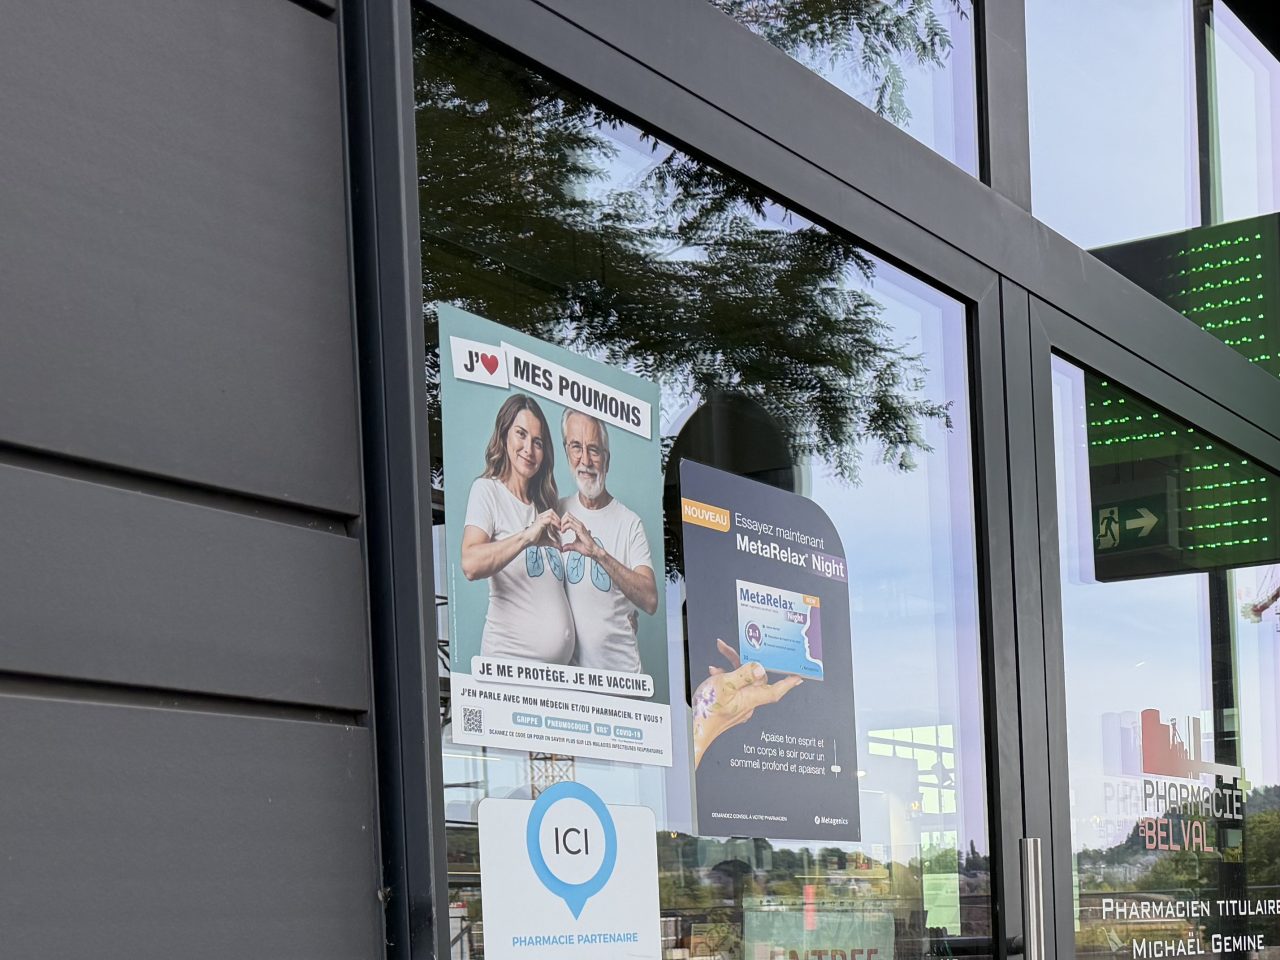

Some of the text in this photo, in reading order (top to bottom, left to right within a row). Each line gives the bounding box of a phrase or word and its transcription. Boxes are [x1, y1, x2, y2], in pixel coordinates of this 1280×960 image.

[514, 356, 553, 391] MES
[559, 375, 641, 427] POUMONS
[684, 504, 727, 526] NOUVEAU
[735, 512, 824, 550] Essayez maintenant
[812, 554, 844, 578] Night
[740, 588, 794, 611] MetaRelax
[787, 612, 804, 623] Night
[479, 662, 651, 692] JE ME PROTÈGE. JE ME VACCINE.
[460, 688, 477, 698] J'EN
[479, 690, 502, 701] PARLE
[502, 693, 520, 704] AVEC
[522, 696, 538, 706] MON
[540, 697, 570, 711] MÉDECIN
[635, 712, 642, 720] ET
[644, 714, 658, 723] VOUS
[516, 715, 538, 725] GRIPPE
[616, 728, 640, 738] COVID-19
[760, 731, 824, 748] Apaise ton esprit et
[744, 744, 756, 755] ton
[757, 746, 777, 758] corps
[786, 748, 798, 758] soir
[800, 751, 815, 762] pour
[817, 753, 825, 762] un
[730, 758, 826, 776] sommeil profond et apaisant
[1143, 779, 1244, 820] PHARMACIE
[554, 827, 589, 855] ICI
[1145, 817, 1214, 852] BELVAL
[1102, 898, 1210, 920] PHARMACIEN
[512, 932, 638, 947] PHARMACIE PARTENAIRE
[1133, 931, 1265, 960] MICHAËL GEMINE
